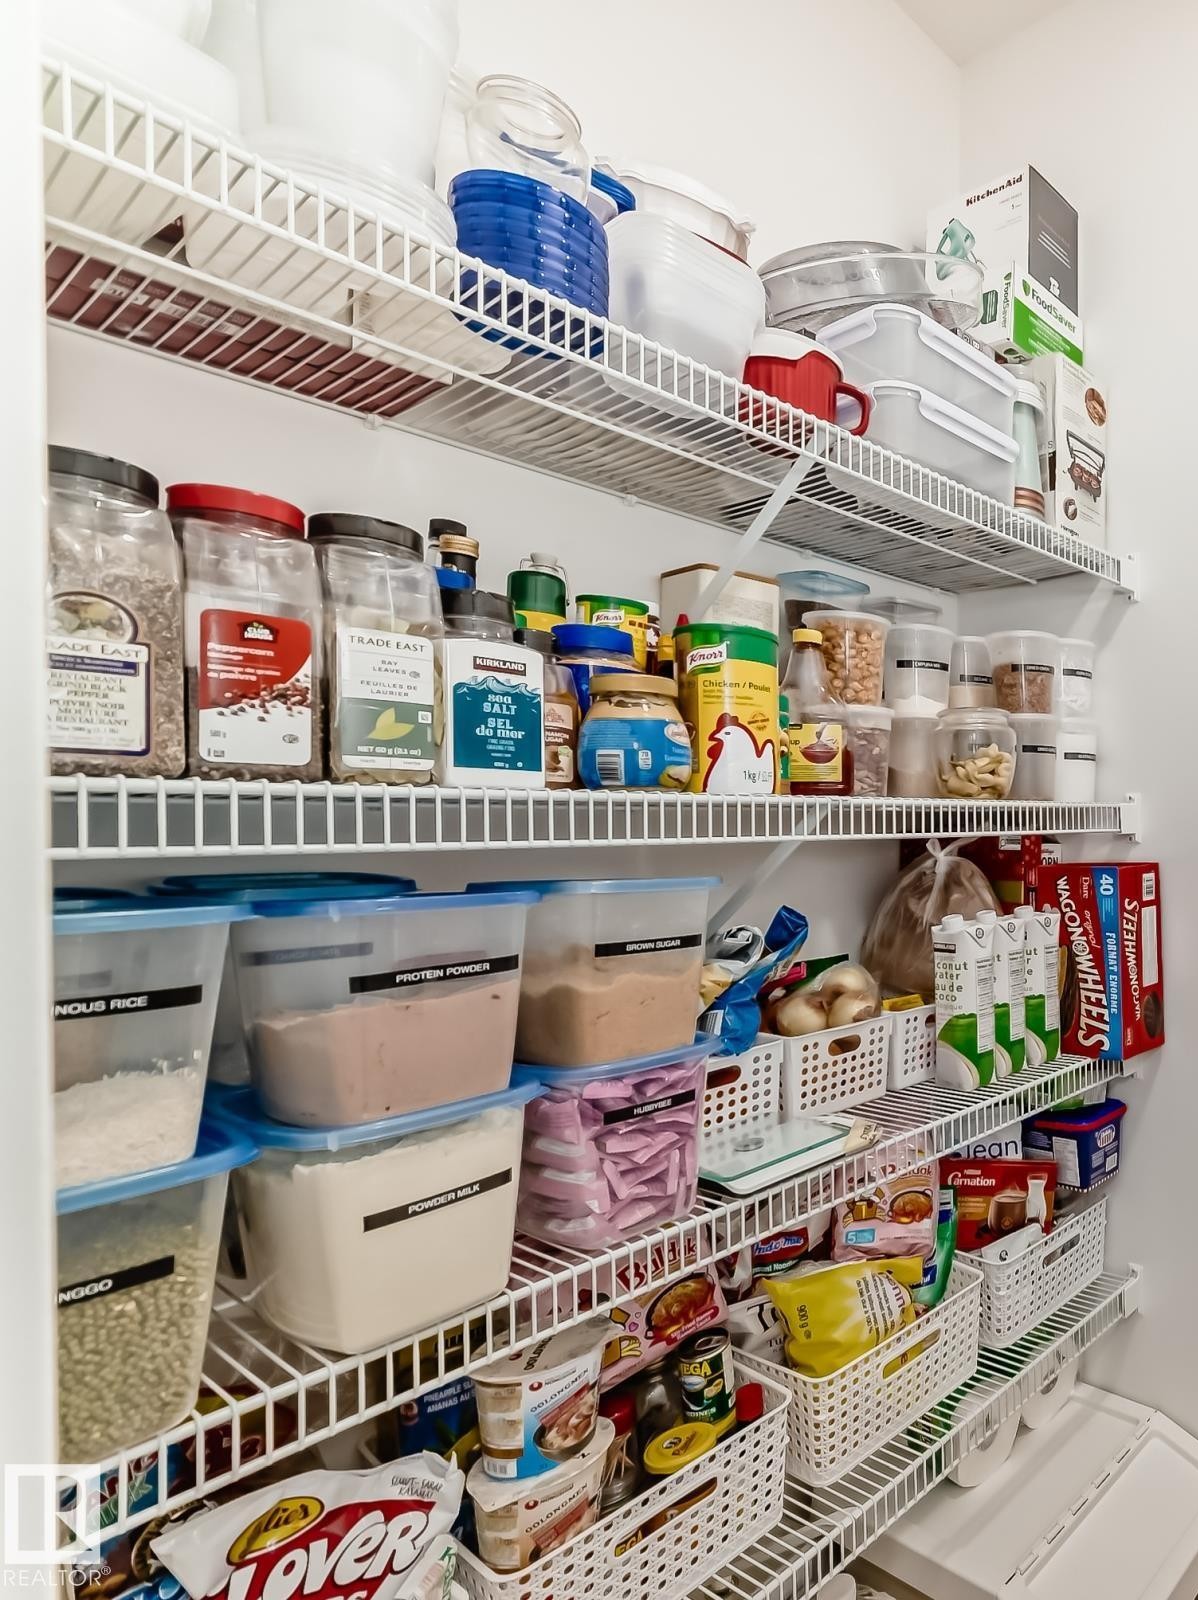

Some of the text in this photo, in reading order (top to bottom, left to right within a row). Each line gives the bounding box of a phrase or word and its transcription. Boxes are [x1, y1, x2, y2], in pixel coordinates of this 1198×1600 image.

[965, 174, 1023, 208] KitchenAid
[1004, 281, 1013, 330] FoodSaver
[1030, 288, 1077, 334] FoodSaver
[349, 635, 426, 653] TRADE EAST
[101, 645, 141, 658] EAST
[689, 650, 723, 665] Knorr
[380, 659, 398, 667] BAY
[475, 657, 525, 671] KIRKLAND
[372, 666, 407, 675] LEAVES
[50, 672, 123, 685] RESTAURANT
[360, 680, 404, 690] FEUILLES
[90, 682, 127, 693] BLACK
[370, 689, 410, 697] LAURIER
[702, 679, 740, 688] Chicken
[748, 681, 771, 693] Poulet
[66, 689, 109, 700] PEPPER
[487, 693, 512, 703] sea
[49, 698, 126, 710] POIVRE NOIR
[482, 702, 518, 715] SALT
[55, 716, 128, 727] RESTAURANT
[487, 717, 514, 729] SEL
[475, 725, 526, 739] de mer
[545, 731, 570, 740] NAMON
[1081, 876, 1090, 899] Dare
[1099, 873, 1115, 896] 40
[625, 939, 681, 951] BROWN SUGAR
[1105, 931, 1118, 972] FORMAT
[395, 962, 491, 984] PROTEIN POWDER
[54, 995, 149, 1017] NOUS RICE
[1075, 953, 1111, 1052] WHEELS
[947, 1171, 996, 1186] Carnation
[408, 1183, 481, 1214] POWDER MILK
[681, 1360, 713, 1377] EGA
[423, 1384, 462, 1403] PINEAPPLE
[530, 1367, 589, 1413] OOLONGMEN
[426, 1396, 459, 1414] ANANAS
[525, 1482, 588, 1534] OOLONGMEN
